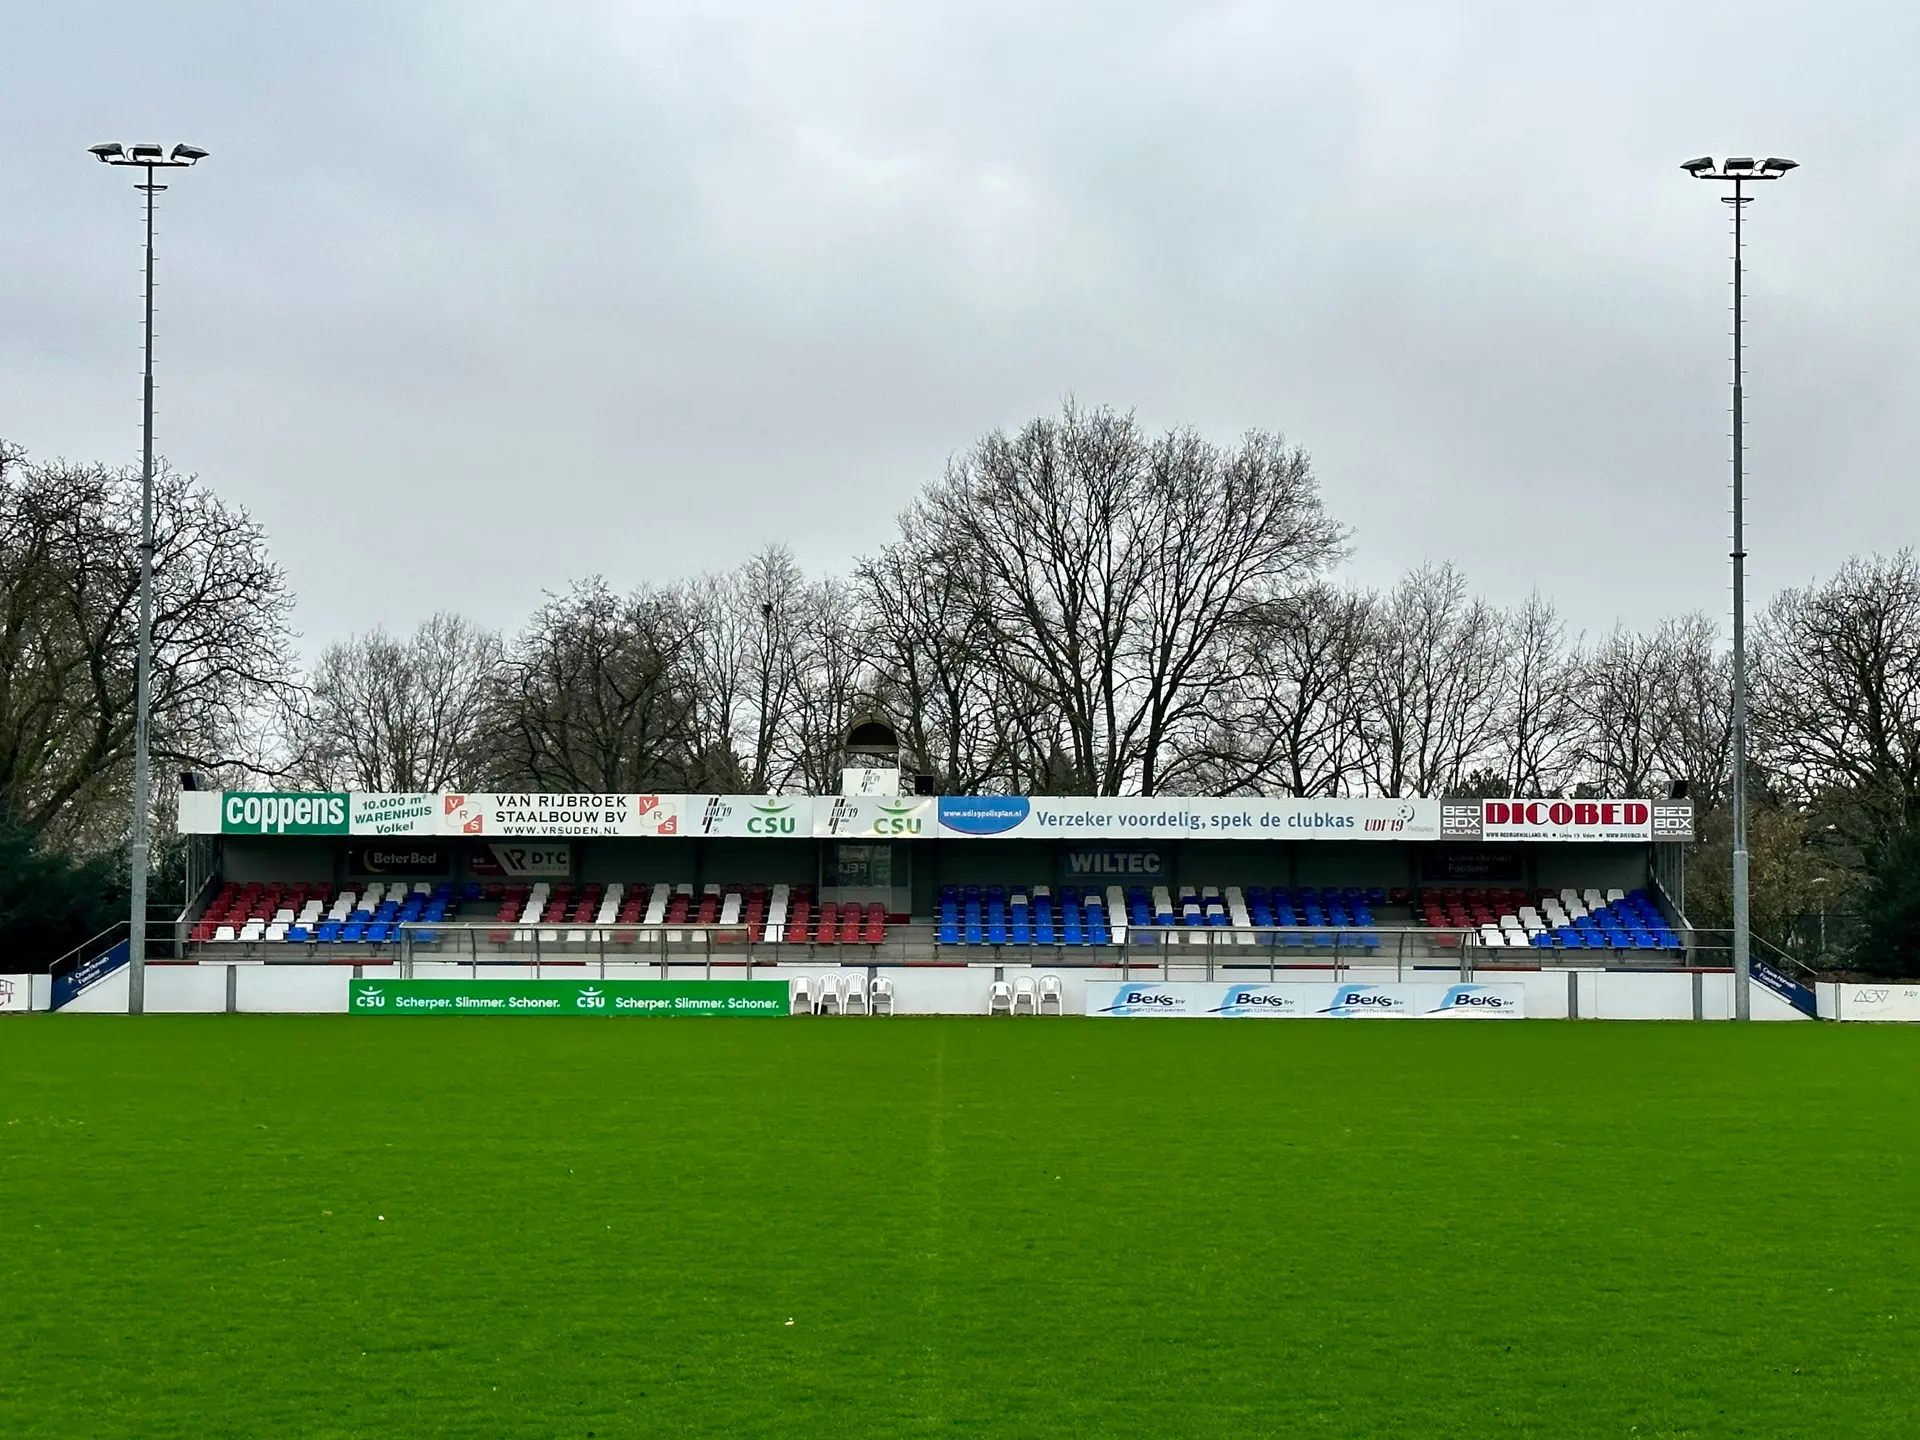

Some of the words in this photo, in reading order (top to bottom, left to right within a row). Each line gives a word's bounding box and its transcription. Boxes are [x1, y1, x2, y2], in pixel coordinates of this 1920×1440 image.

[362, 796, 406, 810] 10.000
[496, 795, 531, 808] VAN
[538, 795, 627, 808] RIJBROEK
[226, 796, 345, 833] coppens
[354, 806, 432, 824] WARENHUIS
[495, 810, 599, 823] STAALBOUW
[605, 811, 628, 823] BV
[1443, 805, 1479, 816] BED
[1485, 802, 1649, 825] DICOBED
[1654, 806, 1692, 817] BED
[375, 820, 414, 834] Volkel
[747, 817, 796, 834] CSU
[873, 818, 922, 835] CSU
[1036, 811, 1113, 827] Verzeker
[1118, 811, 1207, 830] voordelig,
[1211, 812, 1253, 830] spek
[1260, 812, 1281, 827] de
[1287, 812, 1355, 828] clubkas
[1443, 817, 1481, 828] BOX
[1654, 818, 1692, 829] BOX
[503, 826, 619, 835] WWW.VRSUDEN.NL
[373, 851, 409, 864] Beter
[410, 851, 437, 864] Bed
[531, 851, 568, 865] DTC
[1069, 852, 1161, 873] WILTEC
[356, 996, 385, 1007] CSU
[395, 996, 452, 1010] Scherper.
[455, 996, 506, 1008] Slimmer.
[508, 996, 561, 1008] Schoner.
[576, 996, 605, 1008] CSU
[615, 997, 672, 1010] Scherper.
[674, 997, 725, 1009] Slimmer.
[727, 997, 780, 1009] Schoner.
